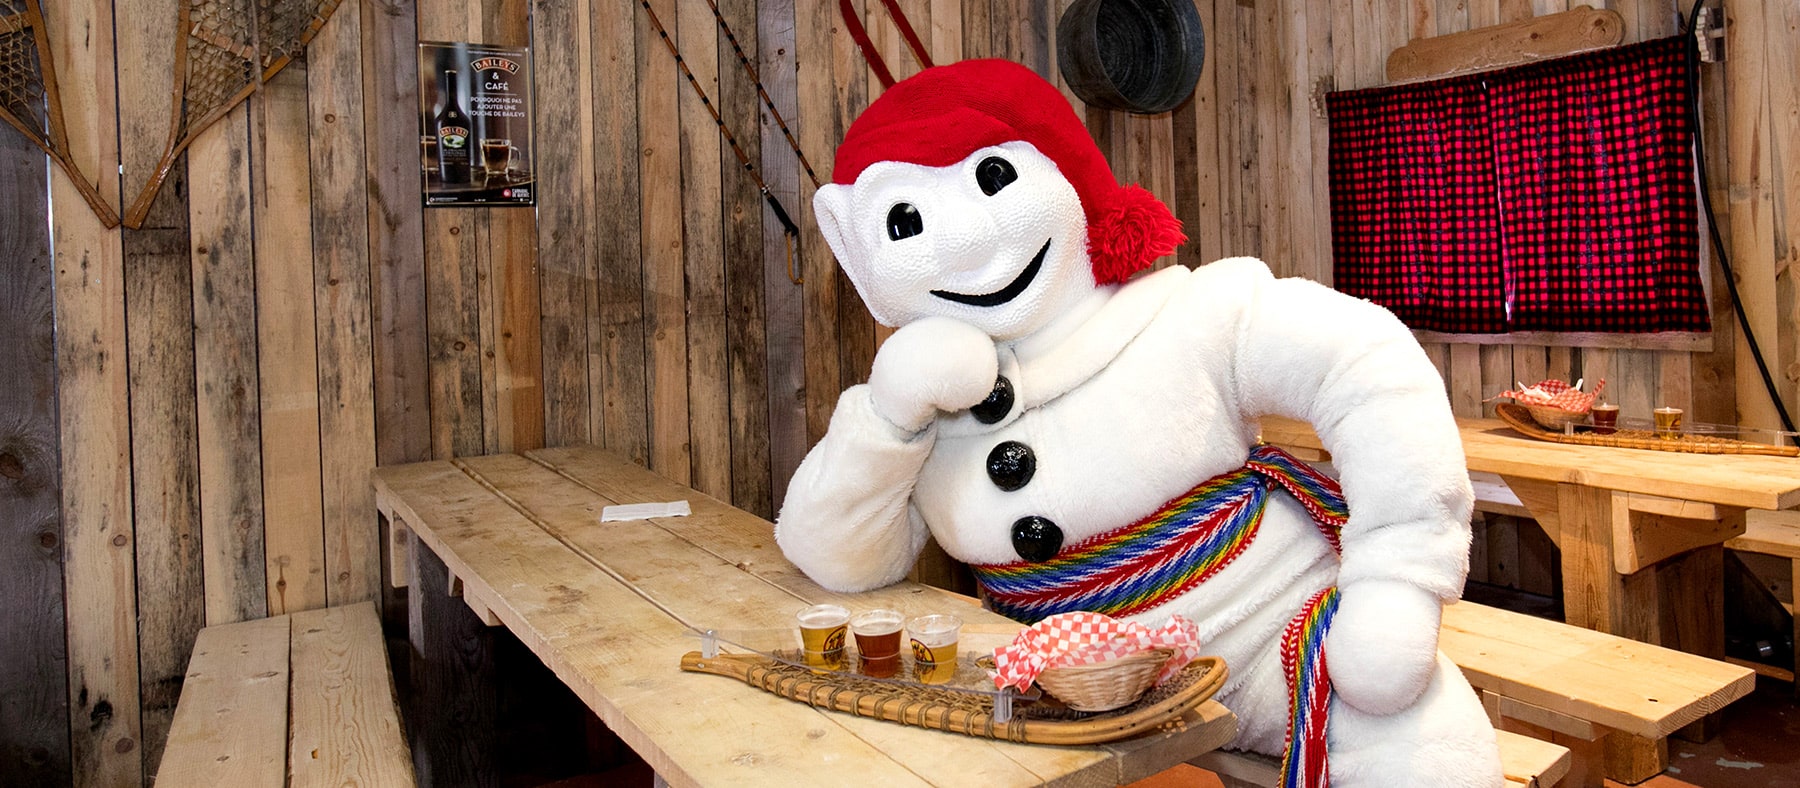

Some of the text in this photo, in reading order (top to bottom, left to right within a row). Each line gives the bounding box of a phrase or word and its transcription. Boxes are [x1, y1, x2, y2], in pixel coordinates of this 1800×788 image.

[475, 59, 516, 71] BAILEYS
[492, 72, 499, 80] &
[485, 81, 509, 91] CAFÉ
